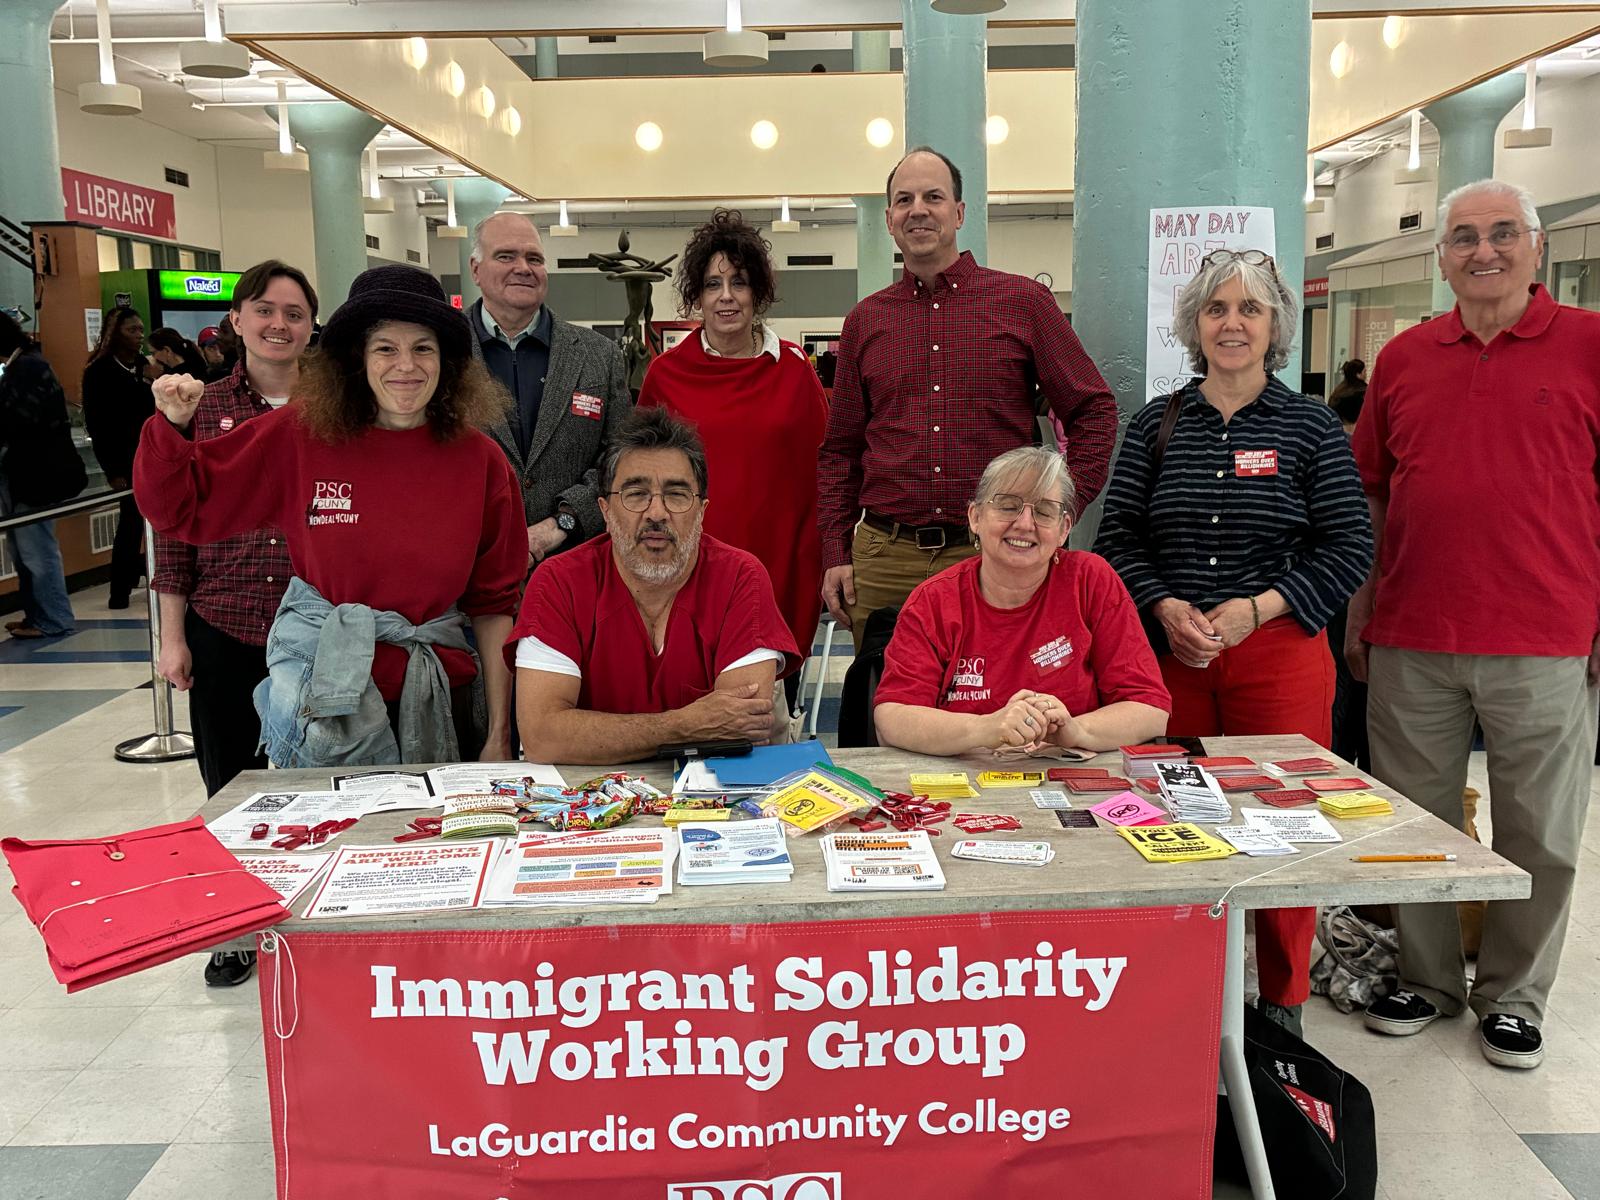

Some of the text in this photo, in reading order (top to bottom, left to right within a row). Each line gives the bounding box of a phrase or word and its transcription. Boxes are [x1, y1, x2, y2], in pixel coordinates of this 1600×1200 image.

[75, 180, 155, 227] LIBRARY
[1155, 212, 1251, 238] MAY DAY
[188, 279, 220, 291] Naked
[315, 481, 352, 499] PSC
[317, 500, 347, 508] CUNY
[956, 657, 985, 675] PSC
[956, 676, 980, 685] CUNY
[451, 798, 509, 807] WORKPLACE
[1131, 830, 1201, 842] ICE
[343, 851, 482, 865] ARE WELCOME
[350, 846, 480, 858] IMMIGRANTS
[370, 941, 1127, 1028] Immigrant Solidarity
[472, 1019, 1026, 1091] Working Group
[428, 1098, 1071, 1158] LaGuardia Community College
